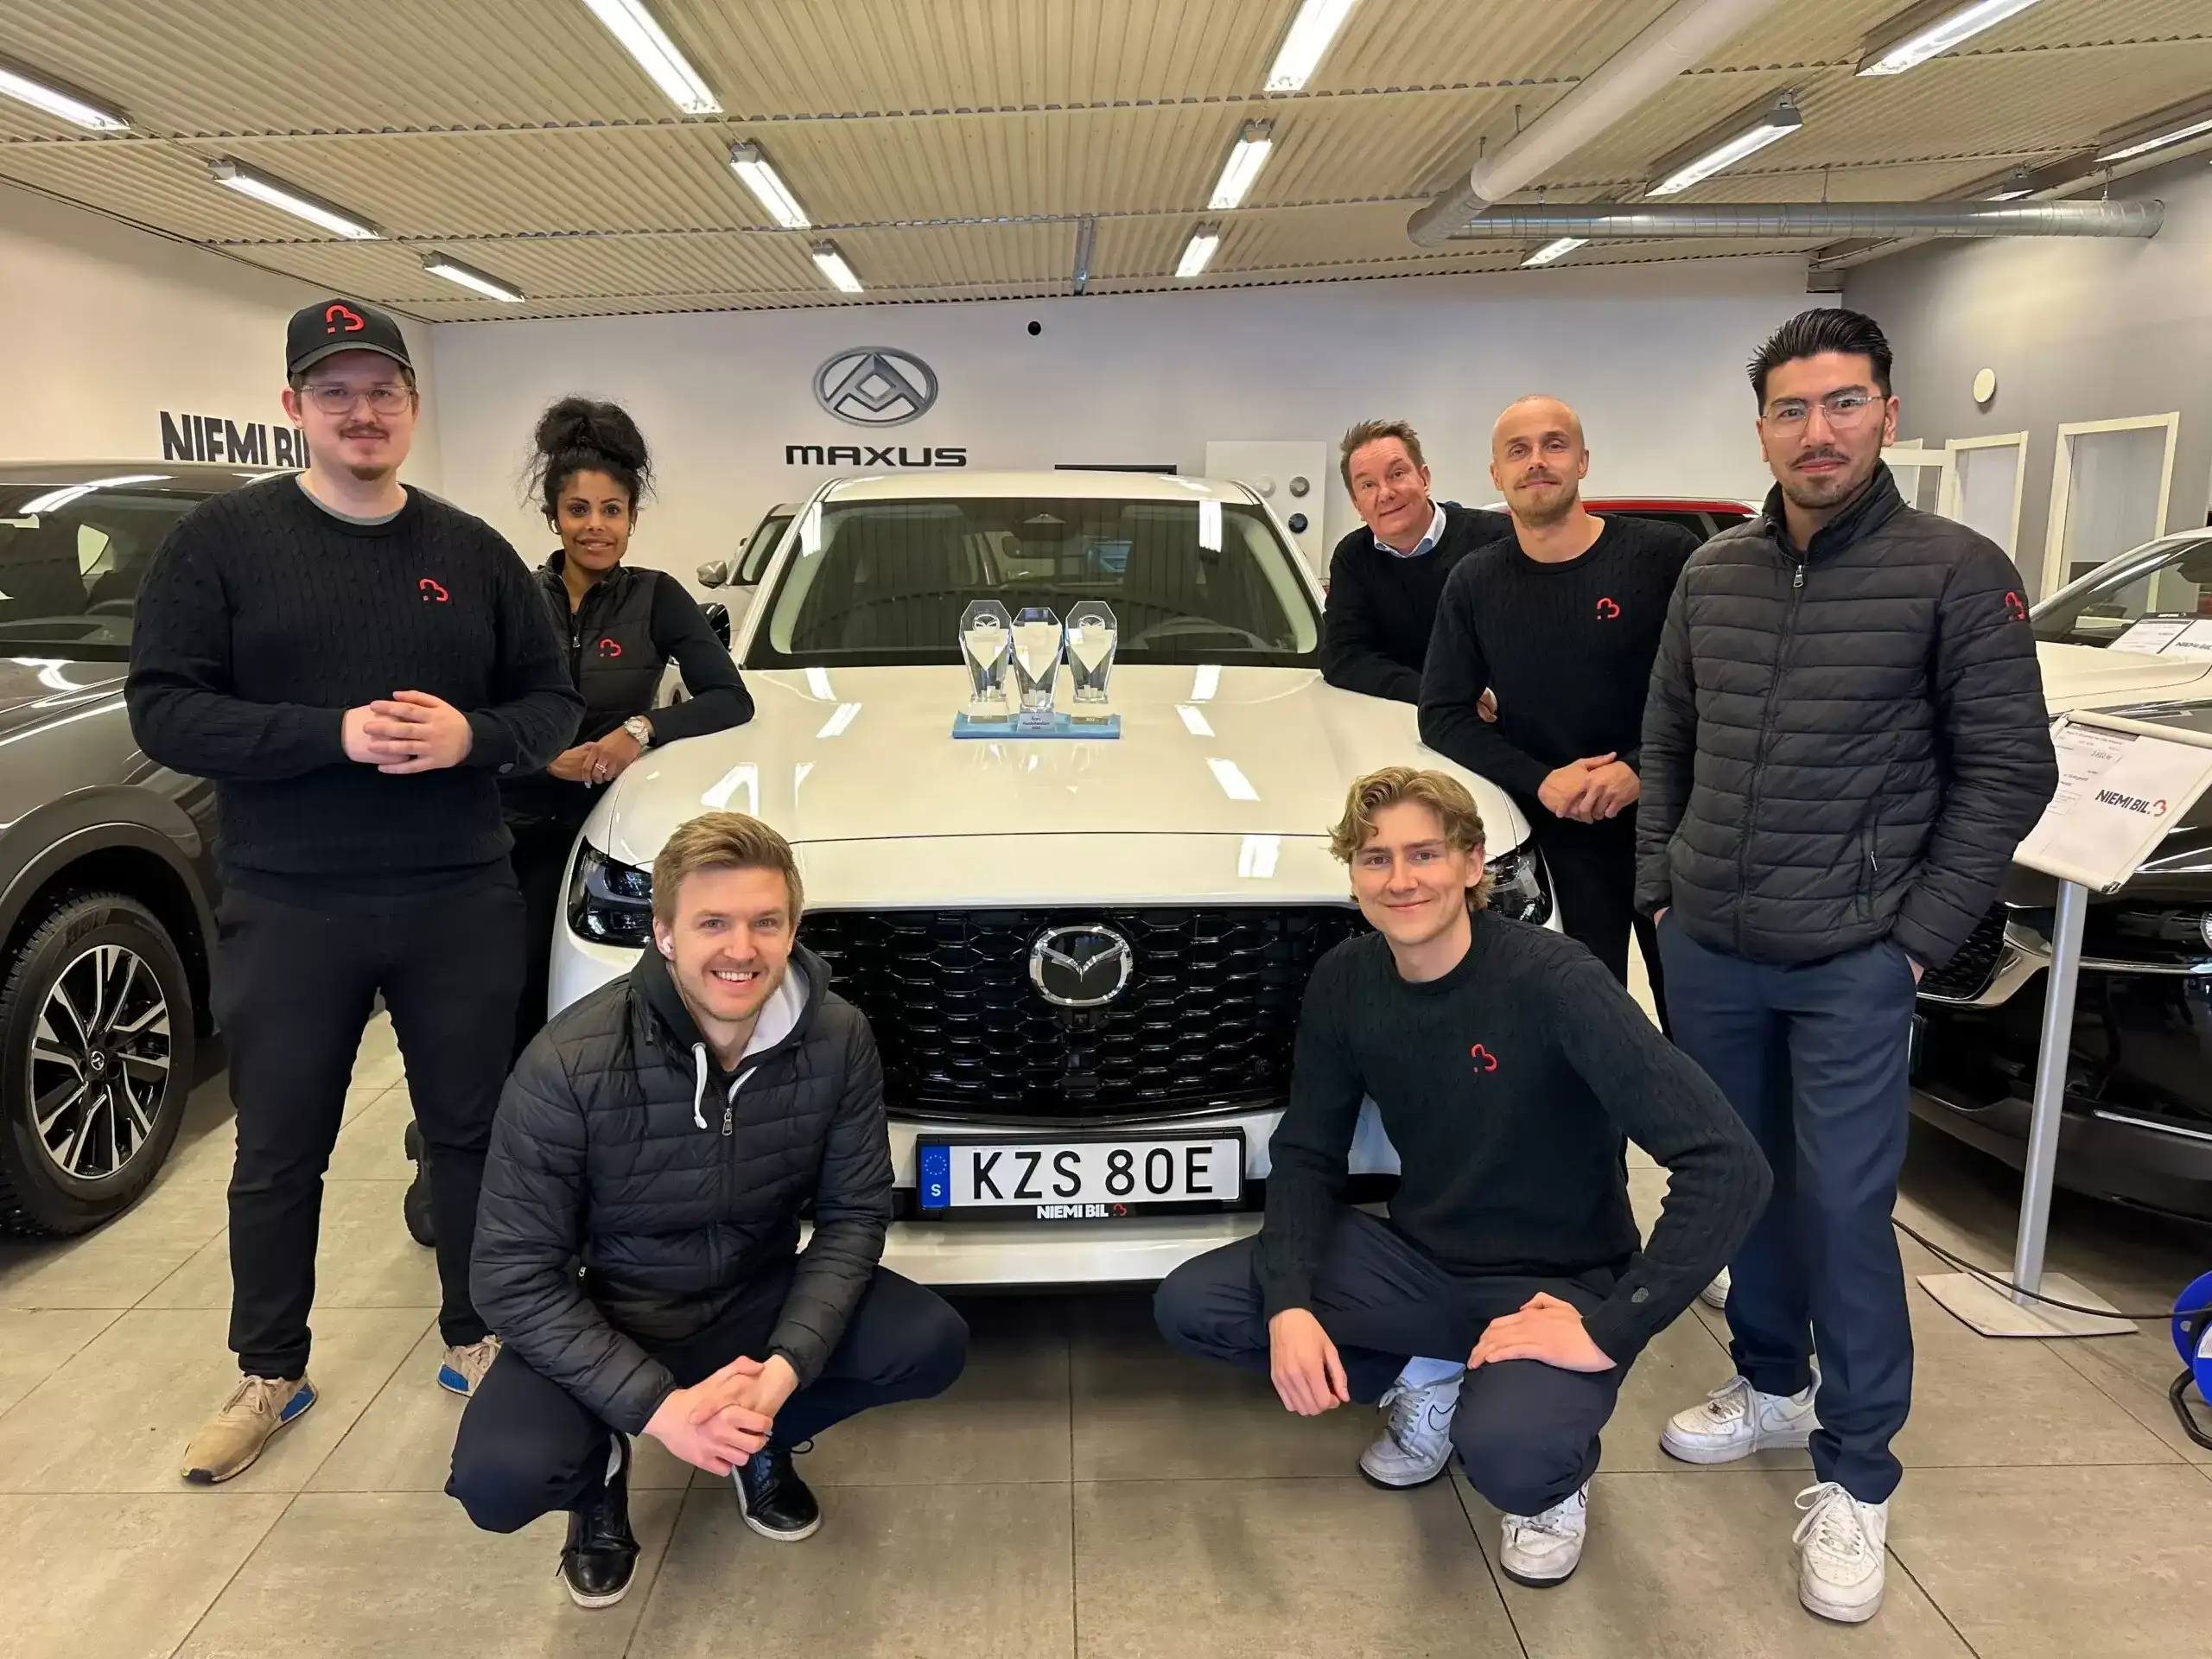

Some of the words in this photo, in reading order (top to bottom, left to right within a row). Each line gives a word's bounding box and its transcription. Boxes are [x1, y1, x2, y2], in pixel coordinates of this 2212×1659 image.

[785, 445, 968, 467] MAXUS
[2094, 789, 2134, 809] NIEMI
[973, 1150, 1082, 1199] KZS
[1105, 1146, 1213, 1196] 80E
[931, 1183, 942, 1197] S
[1037, 1205, 1084, 1219] NIEMI
[1085, 1204, 1109, 1218] BIL
